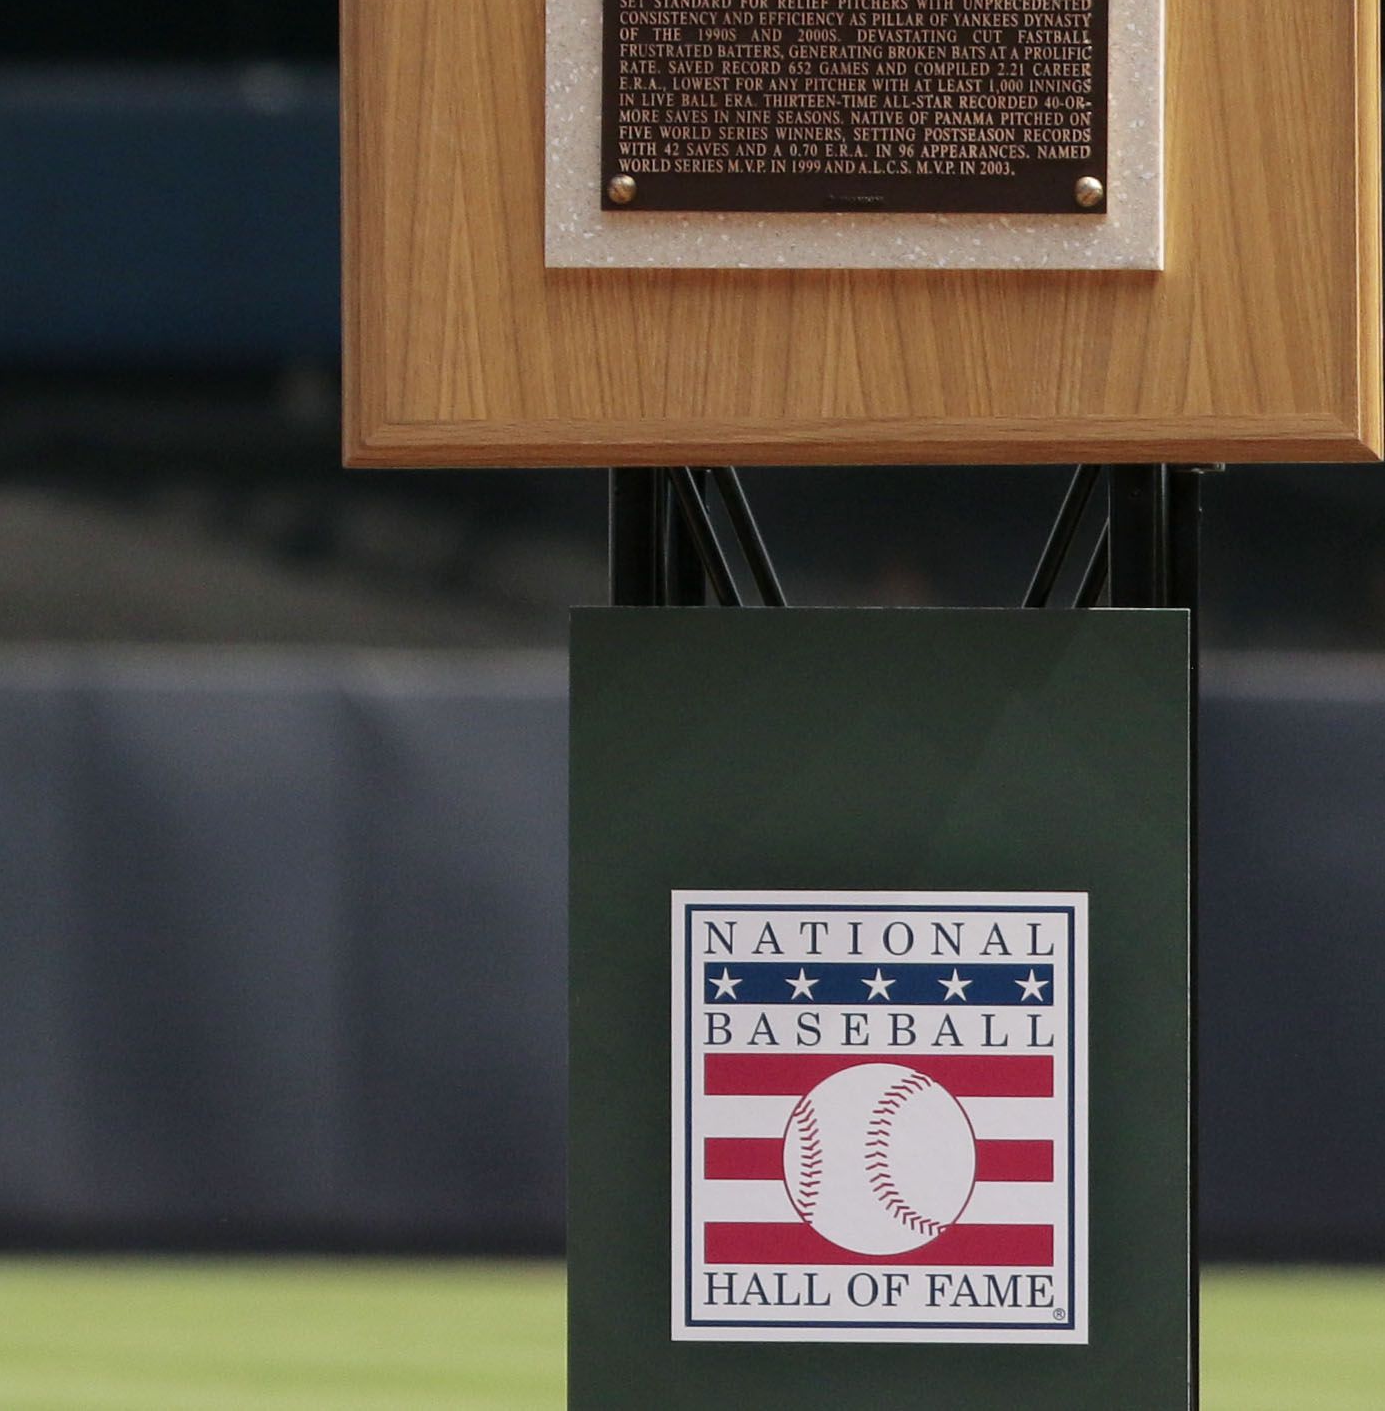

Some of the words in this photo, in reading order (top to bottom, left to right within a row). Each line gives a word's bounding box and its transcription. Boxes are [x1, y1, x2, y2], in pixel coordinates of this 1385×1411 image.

[620, 11, 722, 26] CONSISTENCY
[723, 11, 753, 26] AND
[759, 12, 844, 27] EFFICIENCY
[849, 12, 866, 27] AS
[872, 12, 924, 27] PILLAR
[930, 12, 948, 27] OF
[953, 13, 1018, 28] YANKEES
[1024, 13, 1092, 28] DYNASTY
[620, 28, 639, 42] OF
[653, 28, 681, 43] THE
[698, 28, 736, 43] 1990S
[751, 28, 781, 43] AND
[798, 28, 841, 43] 2000S.
[857, 29, 957, 44] DEVASTATING
[972, 29, 1003, 44] CUT
[1018, 29, 1091, 45] FASTBALL
[620, 44, 712, 59] FRUSTRATED
[718, 44, 784, 61] BATTERS,
[789, 45, 882, 60] GENERATING
[888, 45, 946, 60] BROKEN
[952, 46, 986, 60] BATS
[989, 46, 1005, 61] AT
[1010, 46, 1019, 61] A
[1024, 46, 1092, 61] PROLIFIC
[620, 60, 660, 75] RATE.
[668, 61, 713, 75] SAVED
[722, 61, 781, 76] RECORD
[788, 61, 811, 76] 652
[819, 61, 868, 76] GAMES
[876, 61, 906, 76] AND
[914, 62, 989, 77] COMPILED
[997, 62, 1023, 77] 2.21
[1033, 62, 1091, 77] CAREER
[619, 77, 666, 94] E.R.A.,
[673, 77, 730, 92] LOWEST
[735, 77, 763, 92] FOR
[769, 77, 799, 92] ANY
[805, 78, 866, 93] PITCHER
[872, 78, 909, 93] WITH
[915, 78, 931, 93] AT
[938, 78, 982, 93] LEAST
[989, 79, 1023, 93] 1,000
[1030, 79, 1091, 94] INNINGS
[620, 93, 634, 108] IN
[642, 93, 674, 108] LIVE
[682, 93, 717, 108] BALL
[725, 94, 757, 109] ERA.
[763, 94, 877, 109] THIRTEEN-TIME
[883, 94, 952, 109] ALL-STAR
[959, 95, 1037, 110] RECORDED
[1044, 95, 1092, 110] 40-OR-
[619, 109, 659, 124] MORE
[665, 110, 708, 125] SAVES
[714, 110, 729, 125] IN
[736, 110, 770, 125] NINE
[777, 110, 844, 125] SEASONS.
[851, 111, 903, 126] NATIVE
[909, 111, 928, 126] OF
[934, 111, 993, 126] PANAMA
[1001, 111, 1063, 126] PITCHED
[1069, 112, 1091, 126] ON
[619, 126, 651, 141] FIVE
[660, 126, 711, 141] WORLD
[719, 126, 768, 141] SERIES
[776, 127, 845, 144] WINNERS,
[853, 127, 915, 142] SETTING
[924, 127, 1015, 143] POSTSEASON
[1024, 128, 1091, 143] RECORDS
[619, 143, 656, 157] WITH
[664, 143, 679, 158] 42
[686, 143, 729, 158] SAVES
[735, 143, 766, 158] AND
[773, 144, 782, 158] A
[789, 144, 817, 158] 0.70
[825, 144, 868, 158] E.R.A.
[876, 144, 891, 159] IN
[898, 144, 914, 159] 96
[921, 144, 1030, 159] APPEARANCES.
[1037, 145, 1091, 160] NAMED
[619, 159, 671, 174] WORLD
[674, 159, 723, 174] SERIES
[728, 160, 766, 174] M.V.P.
[771, 160, 786, 174] IN
[792, 160, 821, 175] 1999
[824, 160, 855, 175] AND
[858, 160, 912, 175] A.L.C.S.
[916, 161, 956, 175] M.V.P.
[960, 161, 975, 175] IN
[980, 161, 1015, 176] 2003.
[704, 922, 1053, 955] NATIONAL
[704, 1013, 1053, 1046] BASEBALL
[704, 1273, 830, 1305] HALL
[848, 1273, 909, 1306] OF
[926, 1274, 1053, 1307] FAME
